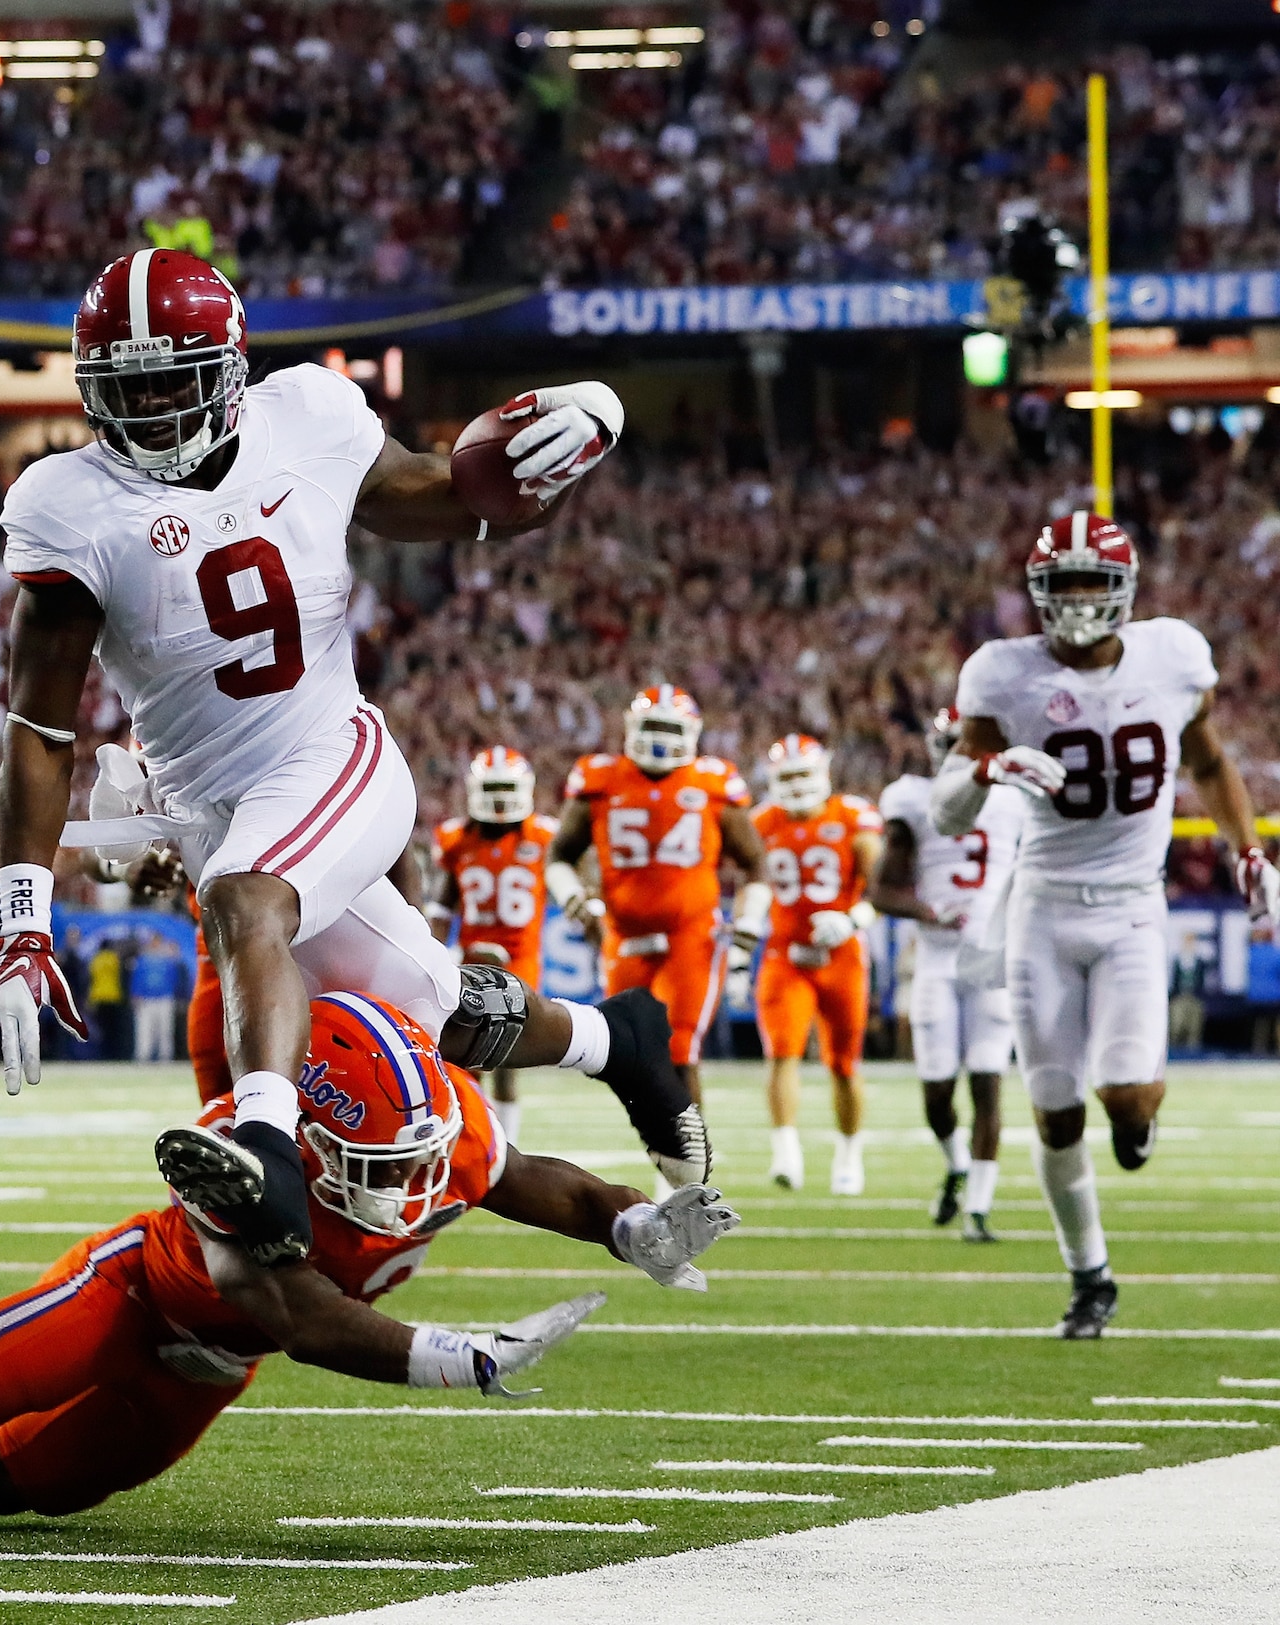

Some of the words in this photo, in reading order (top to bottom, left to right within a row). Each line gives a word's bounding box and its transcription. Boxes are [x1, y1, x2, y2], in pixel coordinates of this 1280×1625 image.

[548, 282, 951, 336] SOUTHEASTERN
[127, 342, 158, 353] BAMA
[151, 516, 190, 555] SEC
[195, 536, 306, 701] 9
[1043, 721, 1167, 819] 88
[607, 807, 703, 869] 54
[10, 878, 34, 919] FREE
[460, 864, 538, 928] 26
[765, 844, 842, 906] 93
